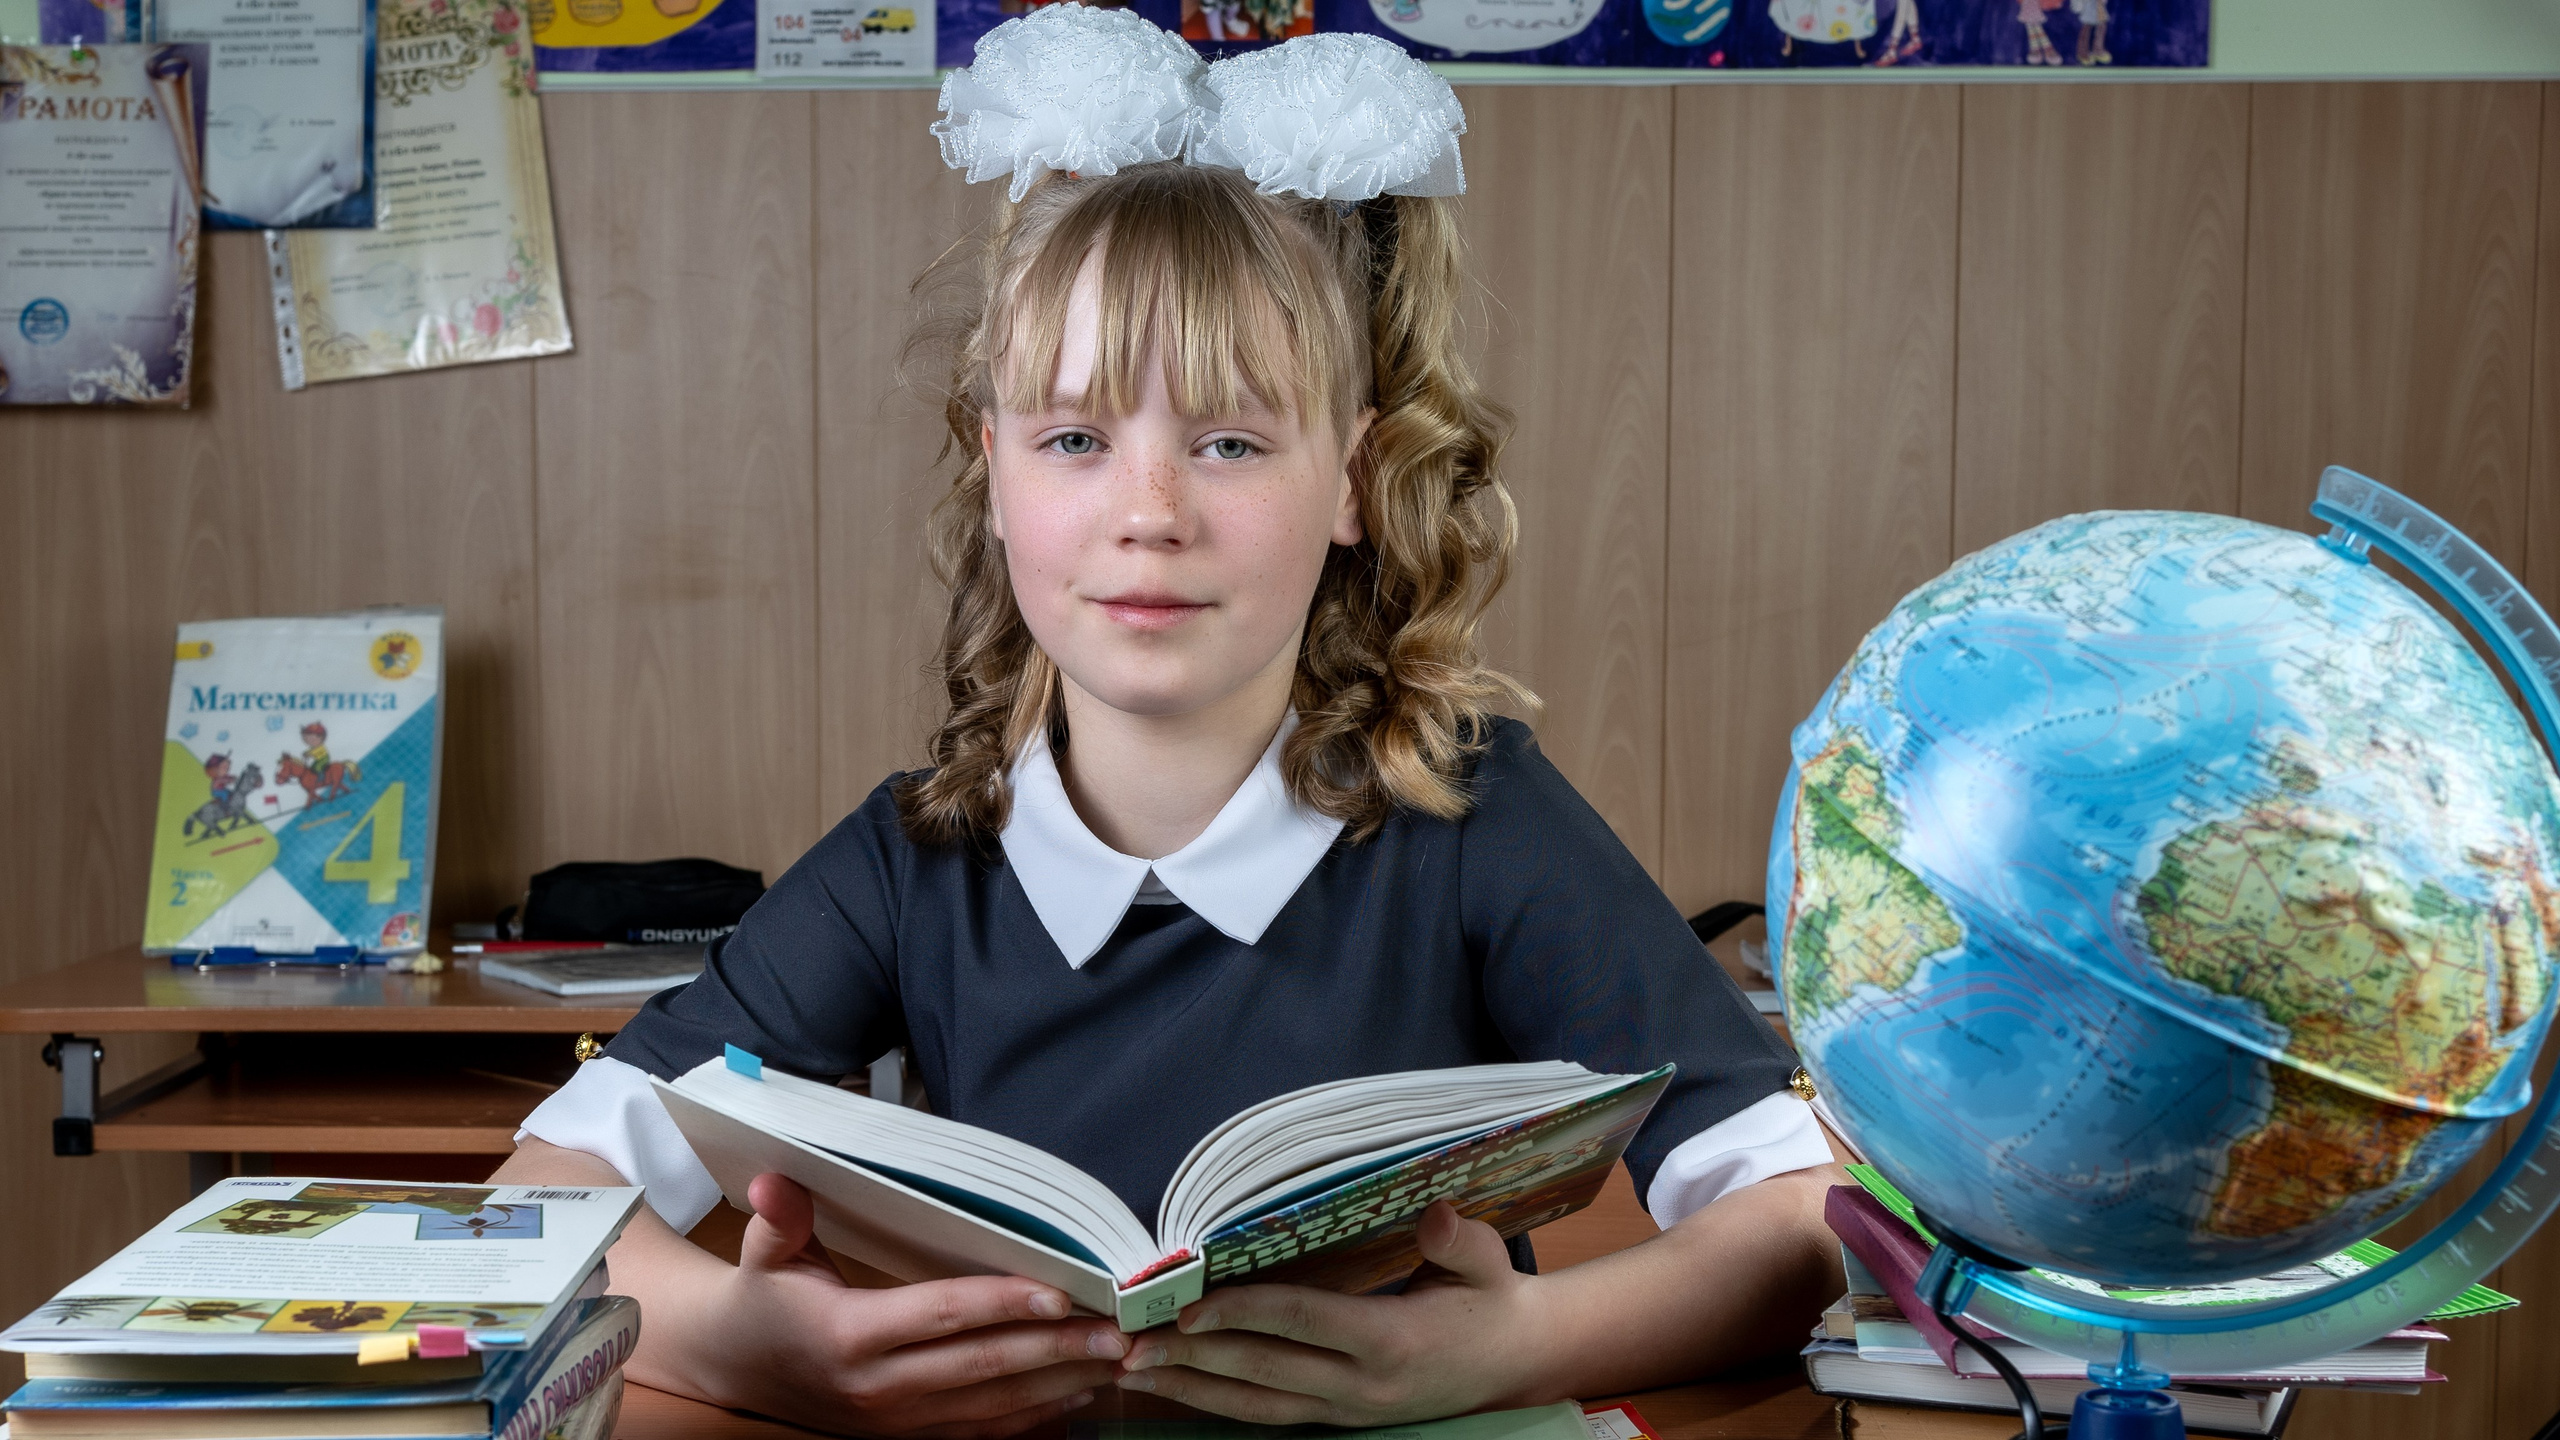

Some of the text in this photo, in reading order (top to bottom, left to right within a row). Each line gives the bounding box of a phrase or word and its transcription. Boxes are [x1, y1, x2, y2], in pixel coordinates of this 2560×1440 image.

[188, 685, 398, 713] Математика
[323, 781, 411, 905] 4
[169, 881, 188, 907] 2
[1209, 1174, 1469, 1272] ЧИТАЕМ
[1211, 1139, 1534, 1267] ГОВОРИМ
